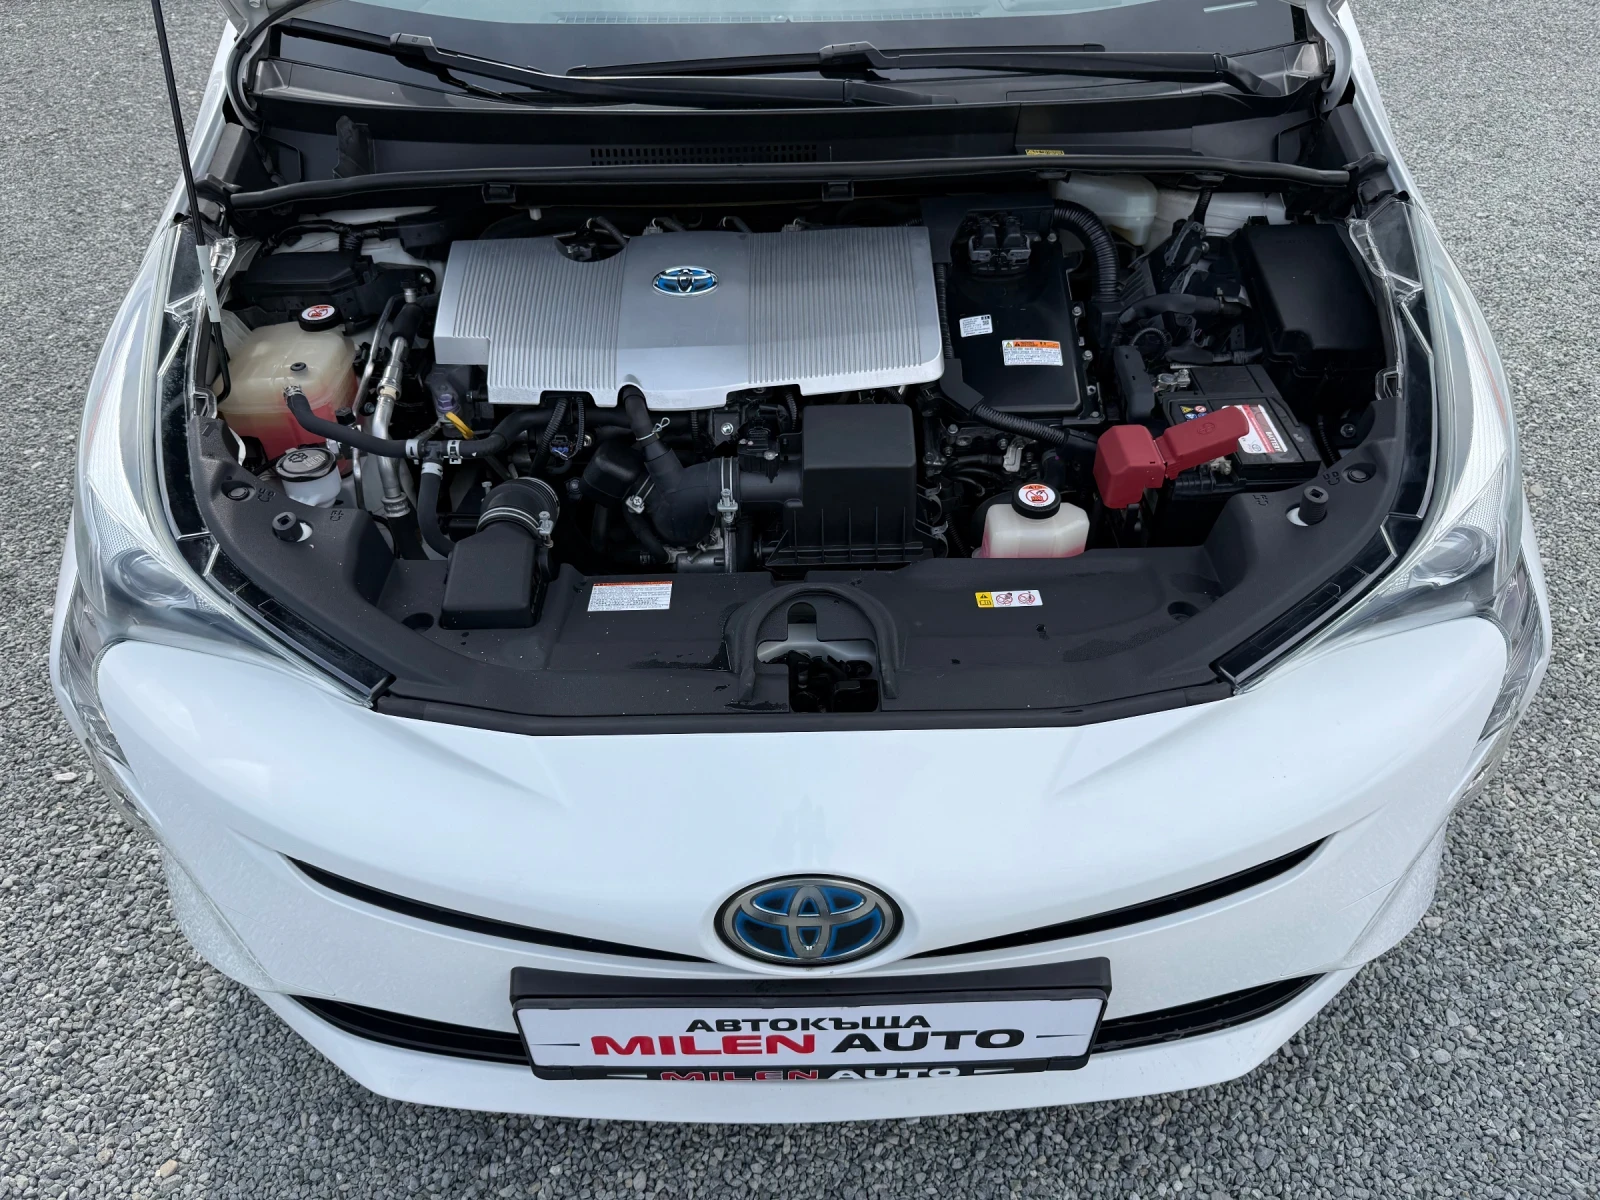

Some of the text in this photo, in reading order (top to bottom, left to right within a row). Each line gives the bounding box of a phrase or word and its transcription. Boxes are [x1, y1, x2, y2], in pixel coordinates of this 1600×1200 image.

[590, 1028, 1025, 1056] MILEN AUTO
[659, 1066, 961, 1082] MILEN AUTO
